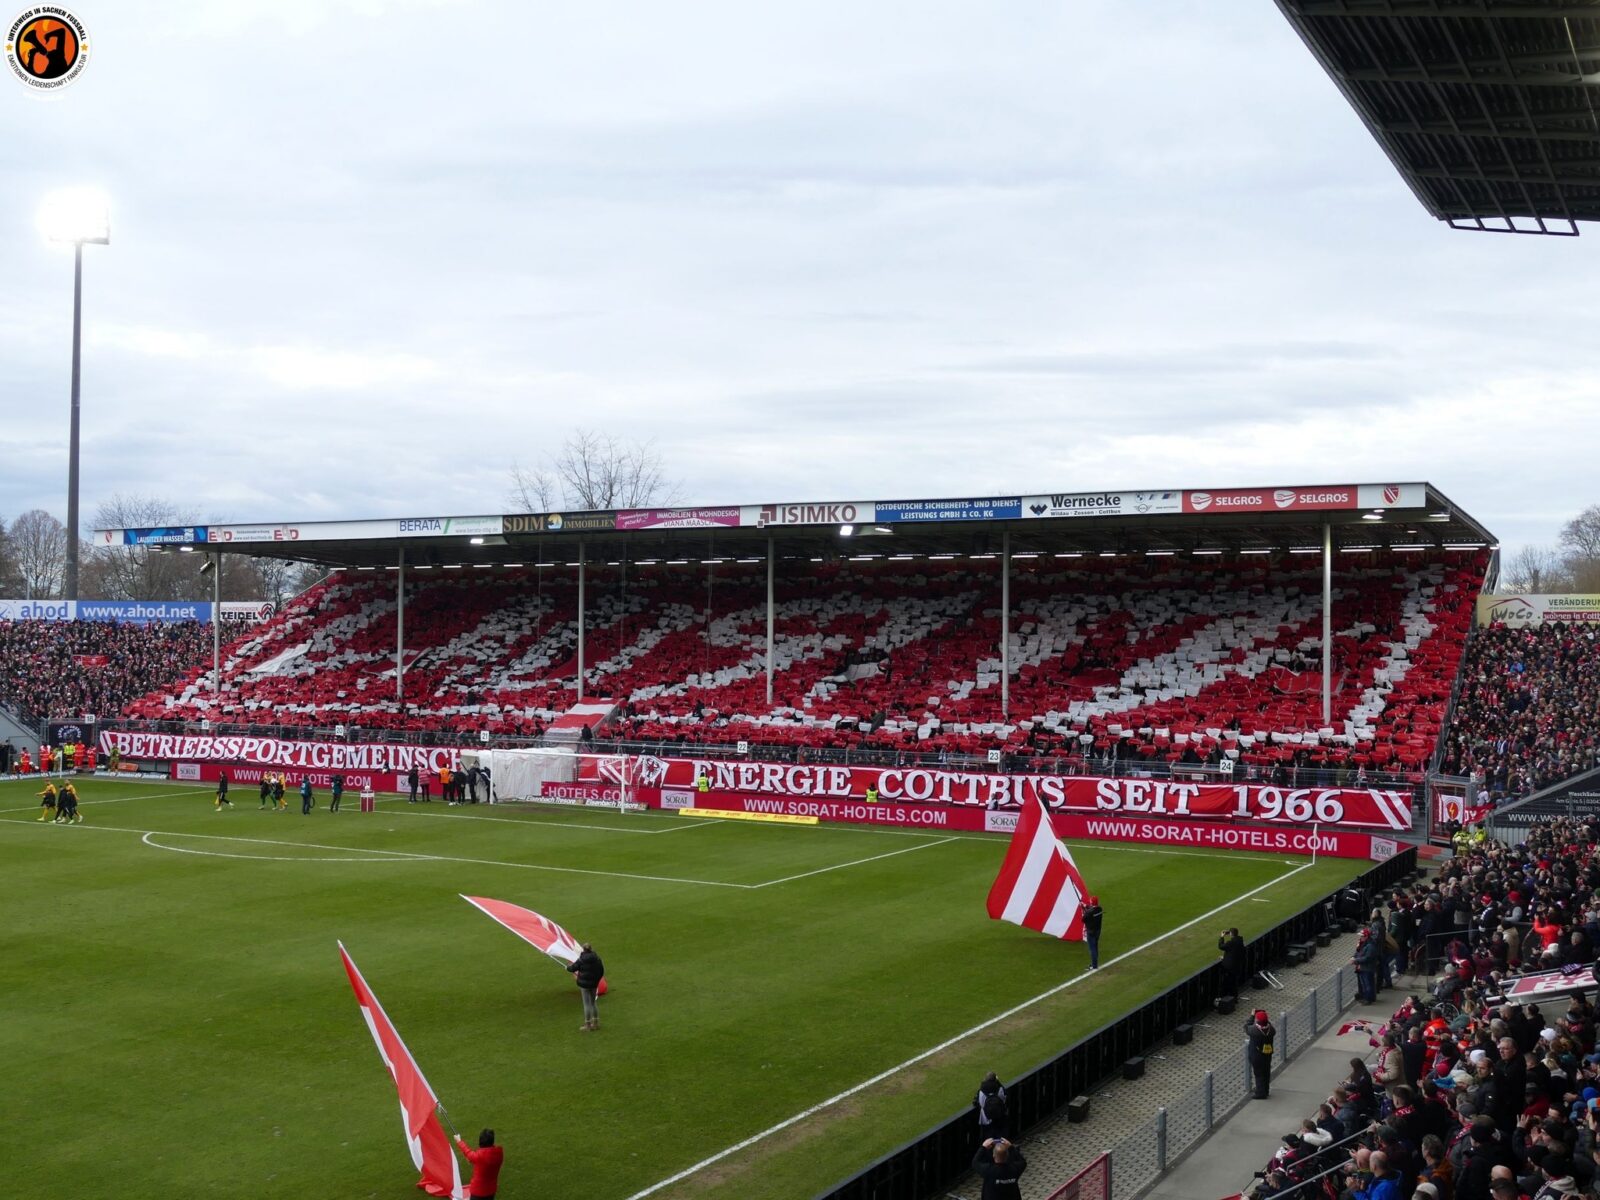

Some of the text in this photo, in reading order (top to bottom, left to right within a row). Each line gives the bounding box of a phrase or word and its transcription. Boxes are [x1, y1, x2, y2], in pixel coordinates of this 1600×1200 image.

[1051, 494, 1121, 508] Wernecke
[1215, 495, 1262, 506] SELGROS
[1299, 492, 1348, 504] SELGROS
[876, 499, 1020, 510] OSTDEUTSCHE SICHERHEITS- UND DIENST-
[656, 511, 691, 519] IMMOBILIEN
[698, 509, 739, 518] WOHNDESIGN
[781, 504, 856, 523] ISIMKO
[901, 511, 938, 519] LEISTUNGS
[969, 510, 981, 518] CO.
[400, 519, 441, 532] BERATA
[504, 516, 544, 532] SDIM
[563, 519, 616, 529] IMMOBILIEN
[20, 602, 69, 619] ahod
[82, 602, 196, 620] www.ahod.net
[220, 611, 258, 620] TEIDEL
[481, 732, 489, 741] 21
[738, 743, 747, 751] 22
[989, 752, 999, 761] 23
[1221, 761, 1232, 771] 24
[690, 759, 1346, 824] ENERGIE COTTBUS SEIT 1966
[665, 795, 688, 805] SORAT
[744, 798, 947, 826] WWW.SORAT-HOTELS.COM
[1086, 819, 1338, 853] WWW.SORAT-HOTELS.COM
[1374, 844, 1392, 857] SORAT
